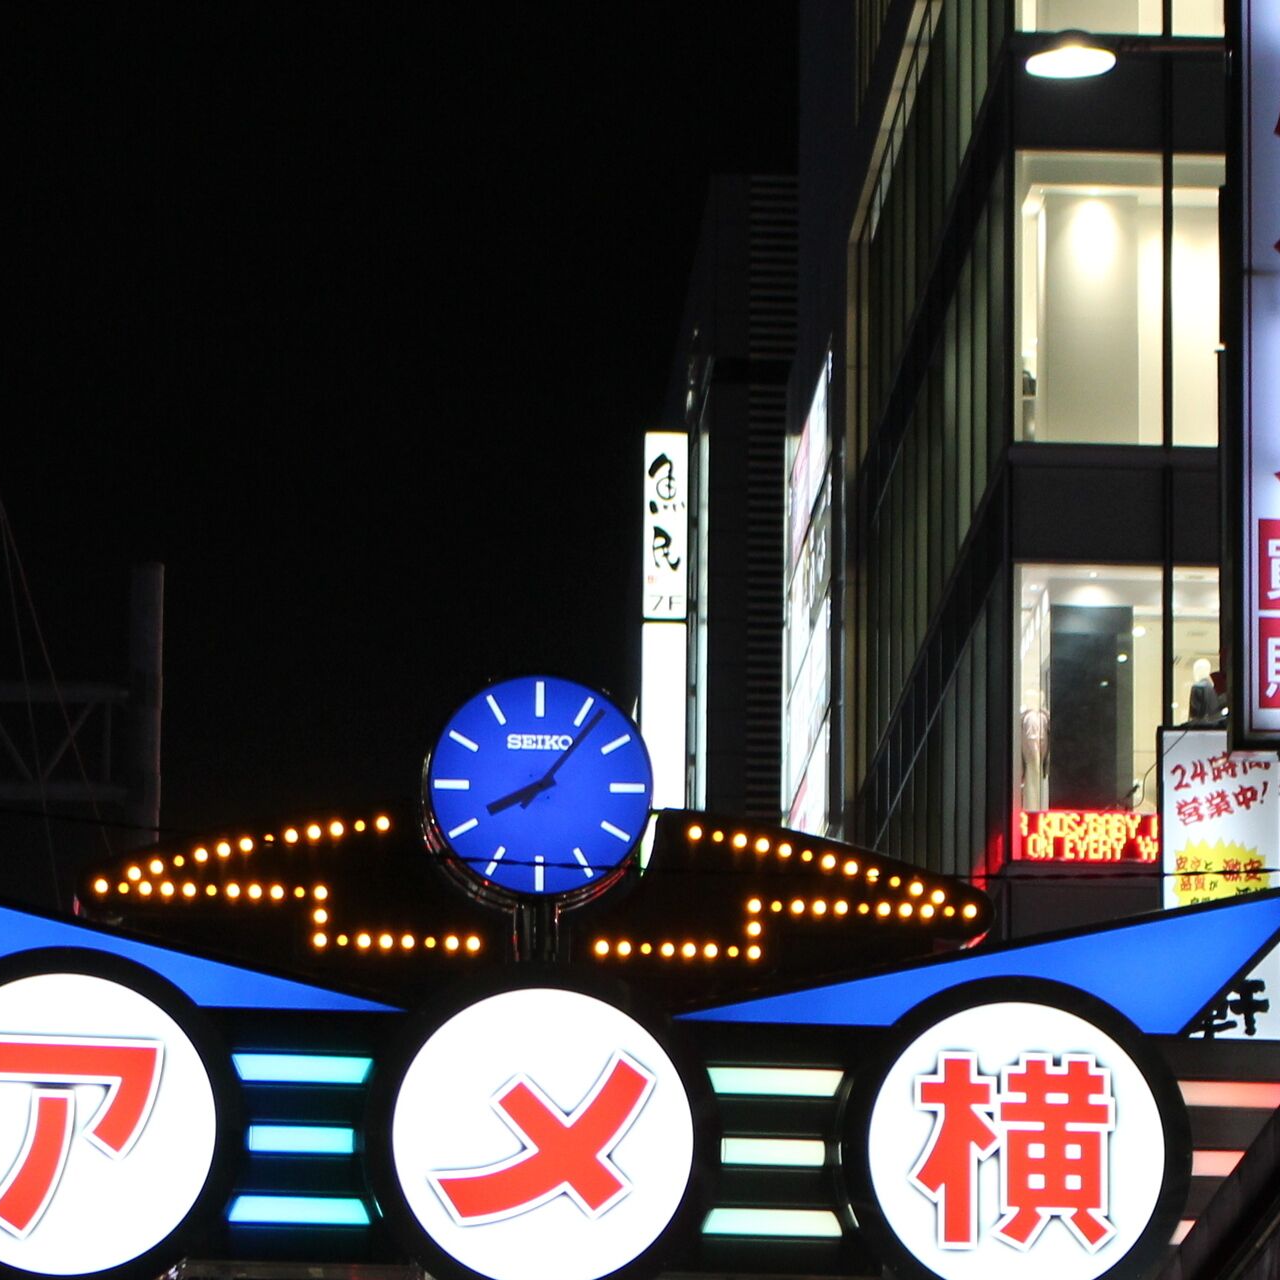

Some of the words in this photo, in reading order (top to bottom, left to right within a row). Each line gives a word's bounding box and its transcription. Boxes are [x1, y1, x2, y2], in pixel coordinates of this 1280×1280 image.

[648, 452, 686, 571] 魚民
[649, 595, 683, 613] 7F
[507, 733, 574, 751] SEIKO
